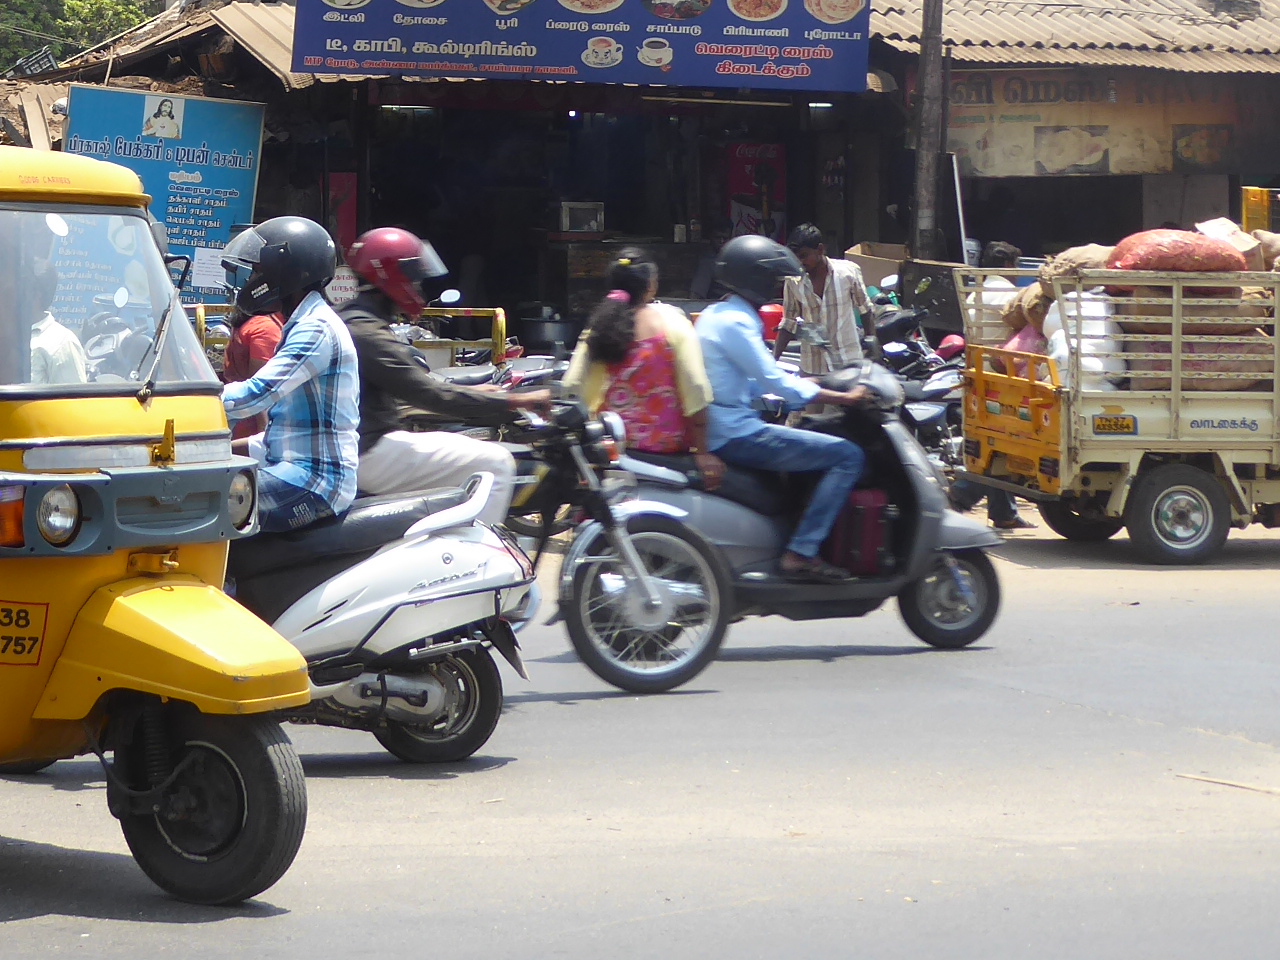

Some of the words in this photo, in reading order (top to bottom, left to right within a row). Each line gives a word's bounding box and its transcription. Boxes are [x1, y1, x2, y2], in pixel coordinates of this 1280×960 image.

[323, 11, 365, 23] இட்லி
[394, 14, 448, 26] தோசை
[496, 18, 518, 30] பூரி
[592, 21, 630, 33] ரைஸ்
[646, 24, 702, 36] சாப்பாடு
[723, 26, 789, 37] பிரியாணி
[805, 28, 861, 40] புரோட்டா
[353, 37, 407, 54] காபி,
[695, 42, 779, 59] வெரைட்டி
[782, 44, 833, 59] ரைஸ்
[304, 56, 323, 66] MTP
[716, 62, 810, 77] கிடைக்கும்
[69, 135, 111, 158] பிரகாஷ்
[114, 136, 164, 160] பேக்கரி
[175, 141, 209, 167] டிபன்
[212, 149, 254, 169] சென்டர்
[168, 184, 212, 195] வெரைட்டி
[204, 198, 228, 208] சாதம்
[1190, 417, 1258, 431] வாடகைக்கு
